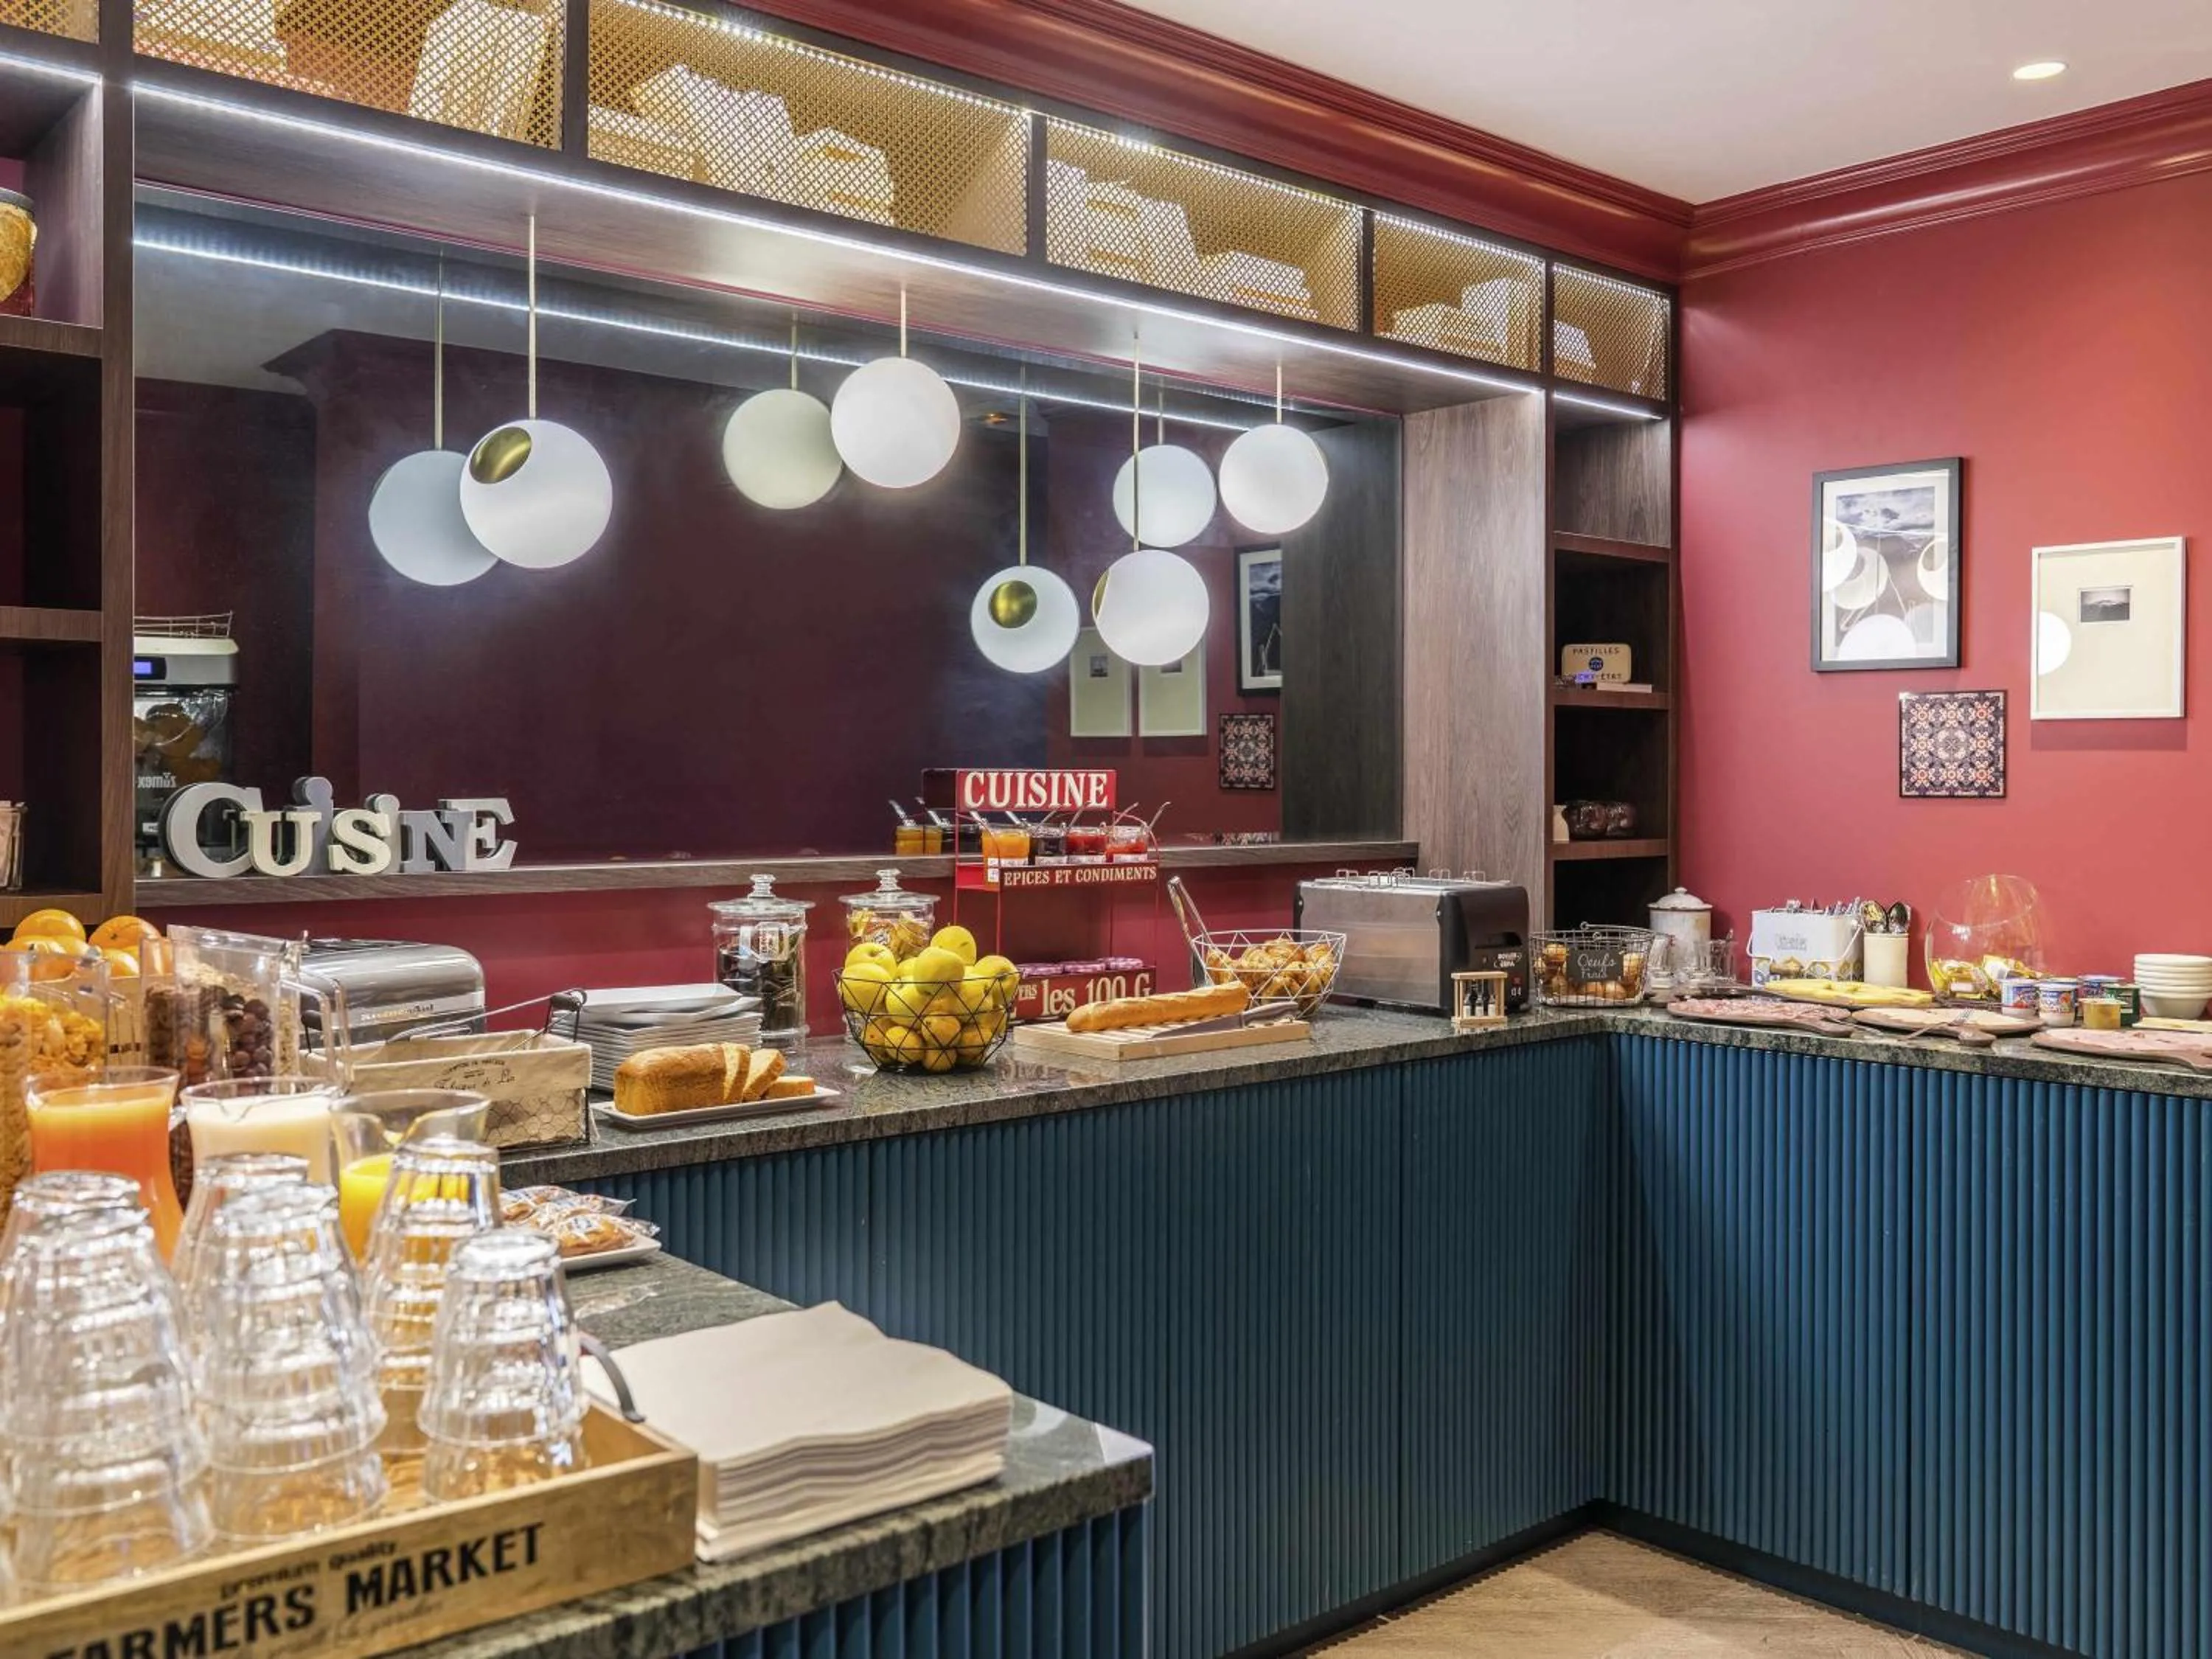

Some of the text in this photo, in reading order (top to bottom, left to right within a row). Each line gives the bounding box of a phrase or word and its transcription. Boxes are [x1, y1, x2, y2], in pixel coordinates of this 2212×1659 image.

[1573, 647, 1621, 655] PASTILLES
[964, 771, 1107, 809] CUISINE
[1004, 869, 1051, 886] EPICES
[1054, 869, 1072, 884] ET
[1075, 866, 1158, 883] CONDIMENTS
[1040, 978, 1076, 1017] les
[1085, 975, 1127, 1005] 100
[1134, 972, 1152, 998] G
[329, 1541, 396, 1571] quality
[44, 1583, 316, 1659] RMERS
[345, 1521, 546, 1615] MARKET
